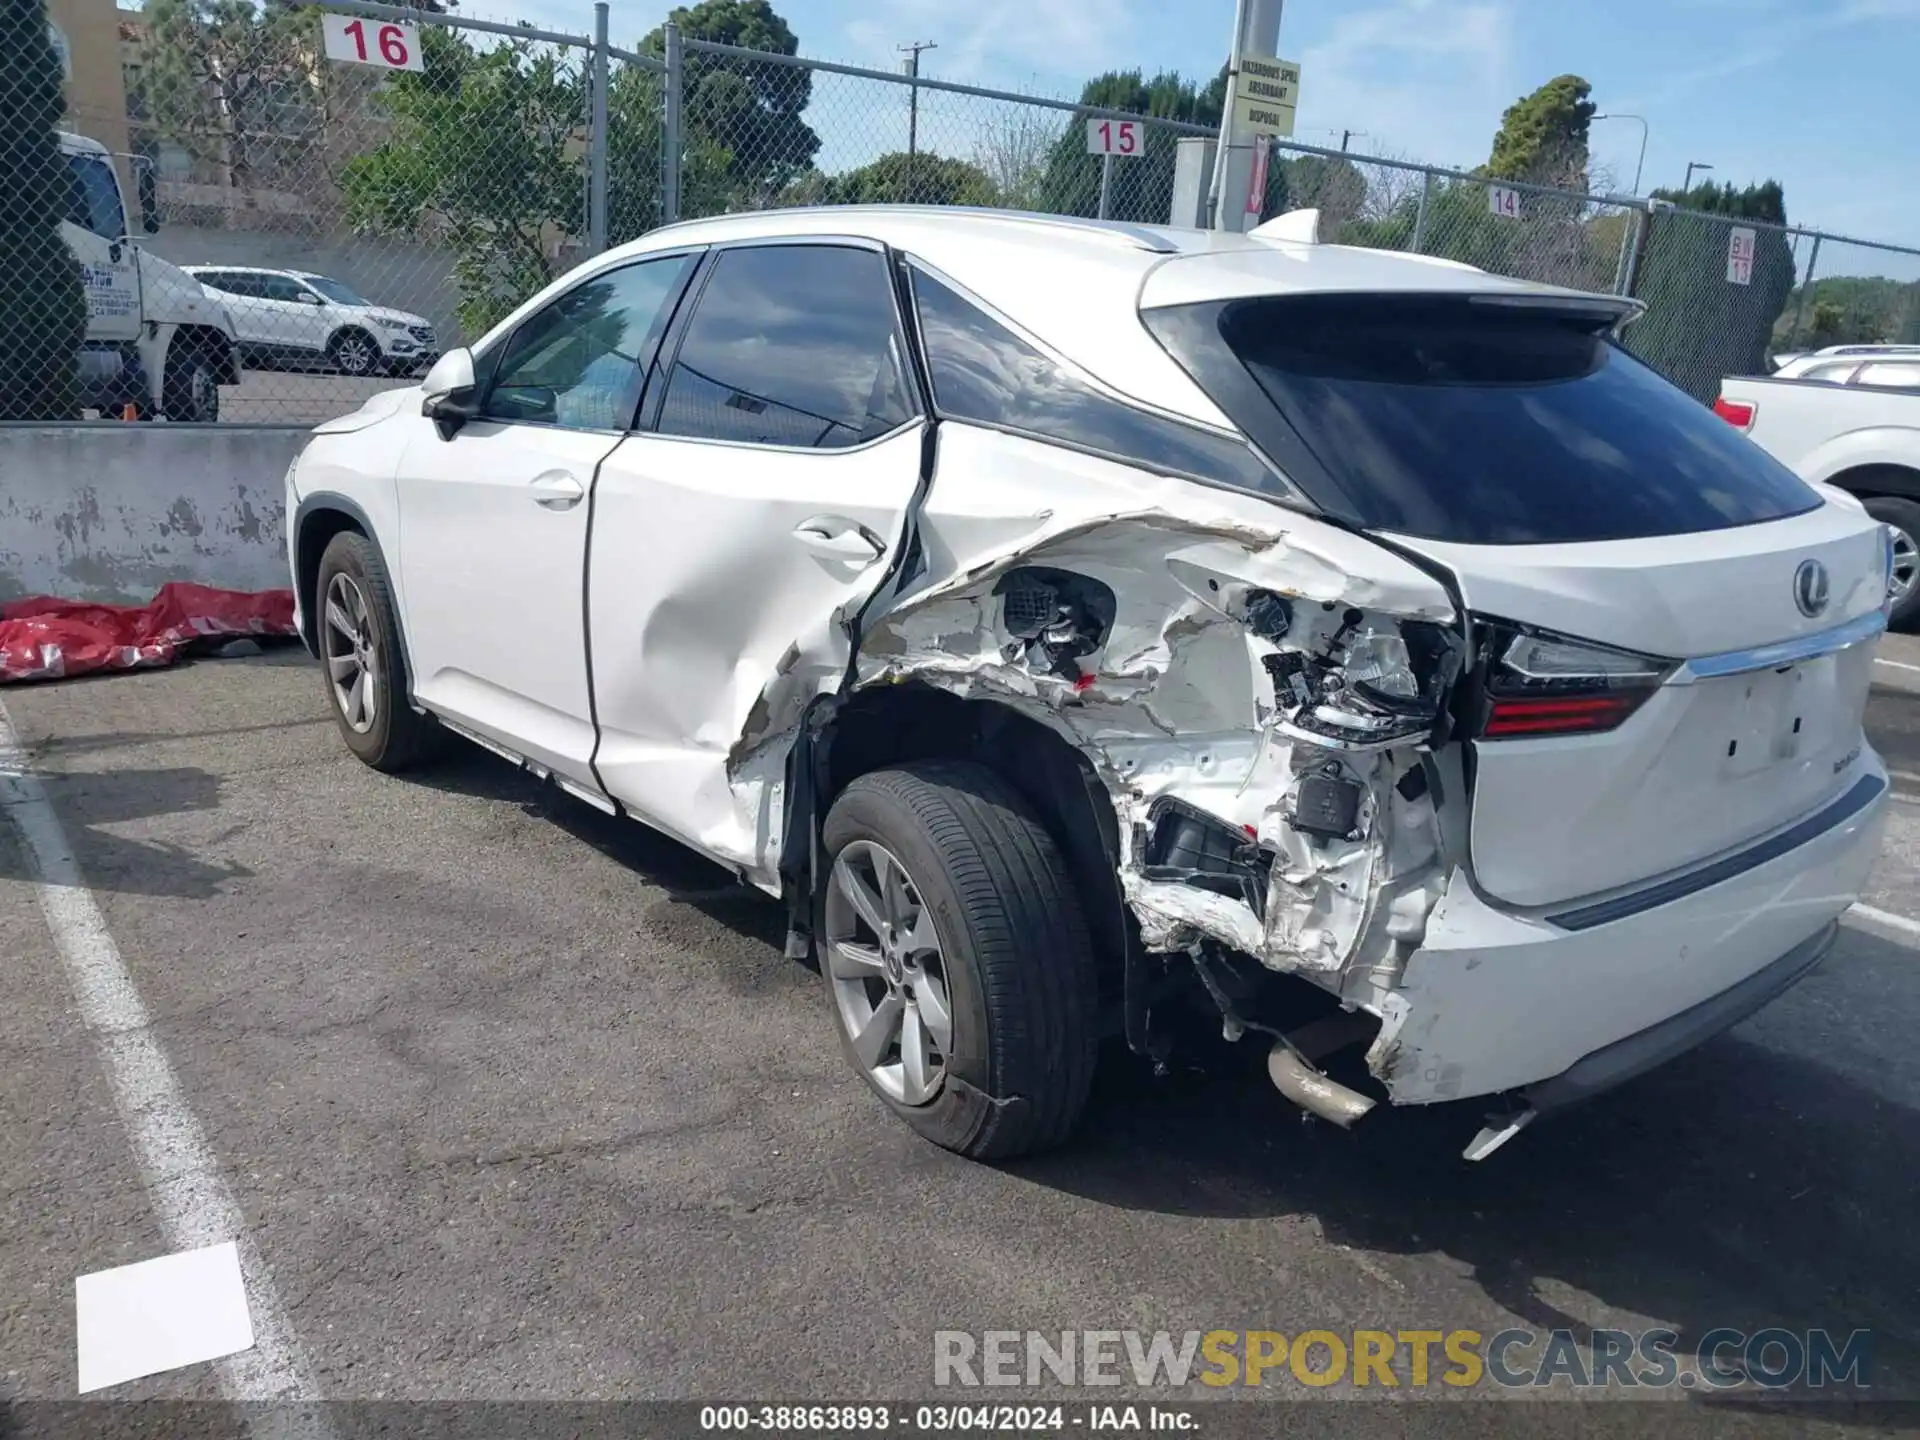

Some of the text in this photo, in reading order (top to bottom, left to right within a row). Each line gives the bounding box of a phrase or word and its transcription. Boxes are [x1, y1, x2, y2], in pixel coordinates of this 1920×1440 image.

[344, 20, 408, 65] 16
[1249, 108, 1279, 126] DISPOSAL
[1098, 121, 1135, 153] 15
[1495, 189, 1513, 216] 14
[1734, 262, 1749, 281] 13
